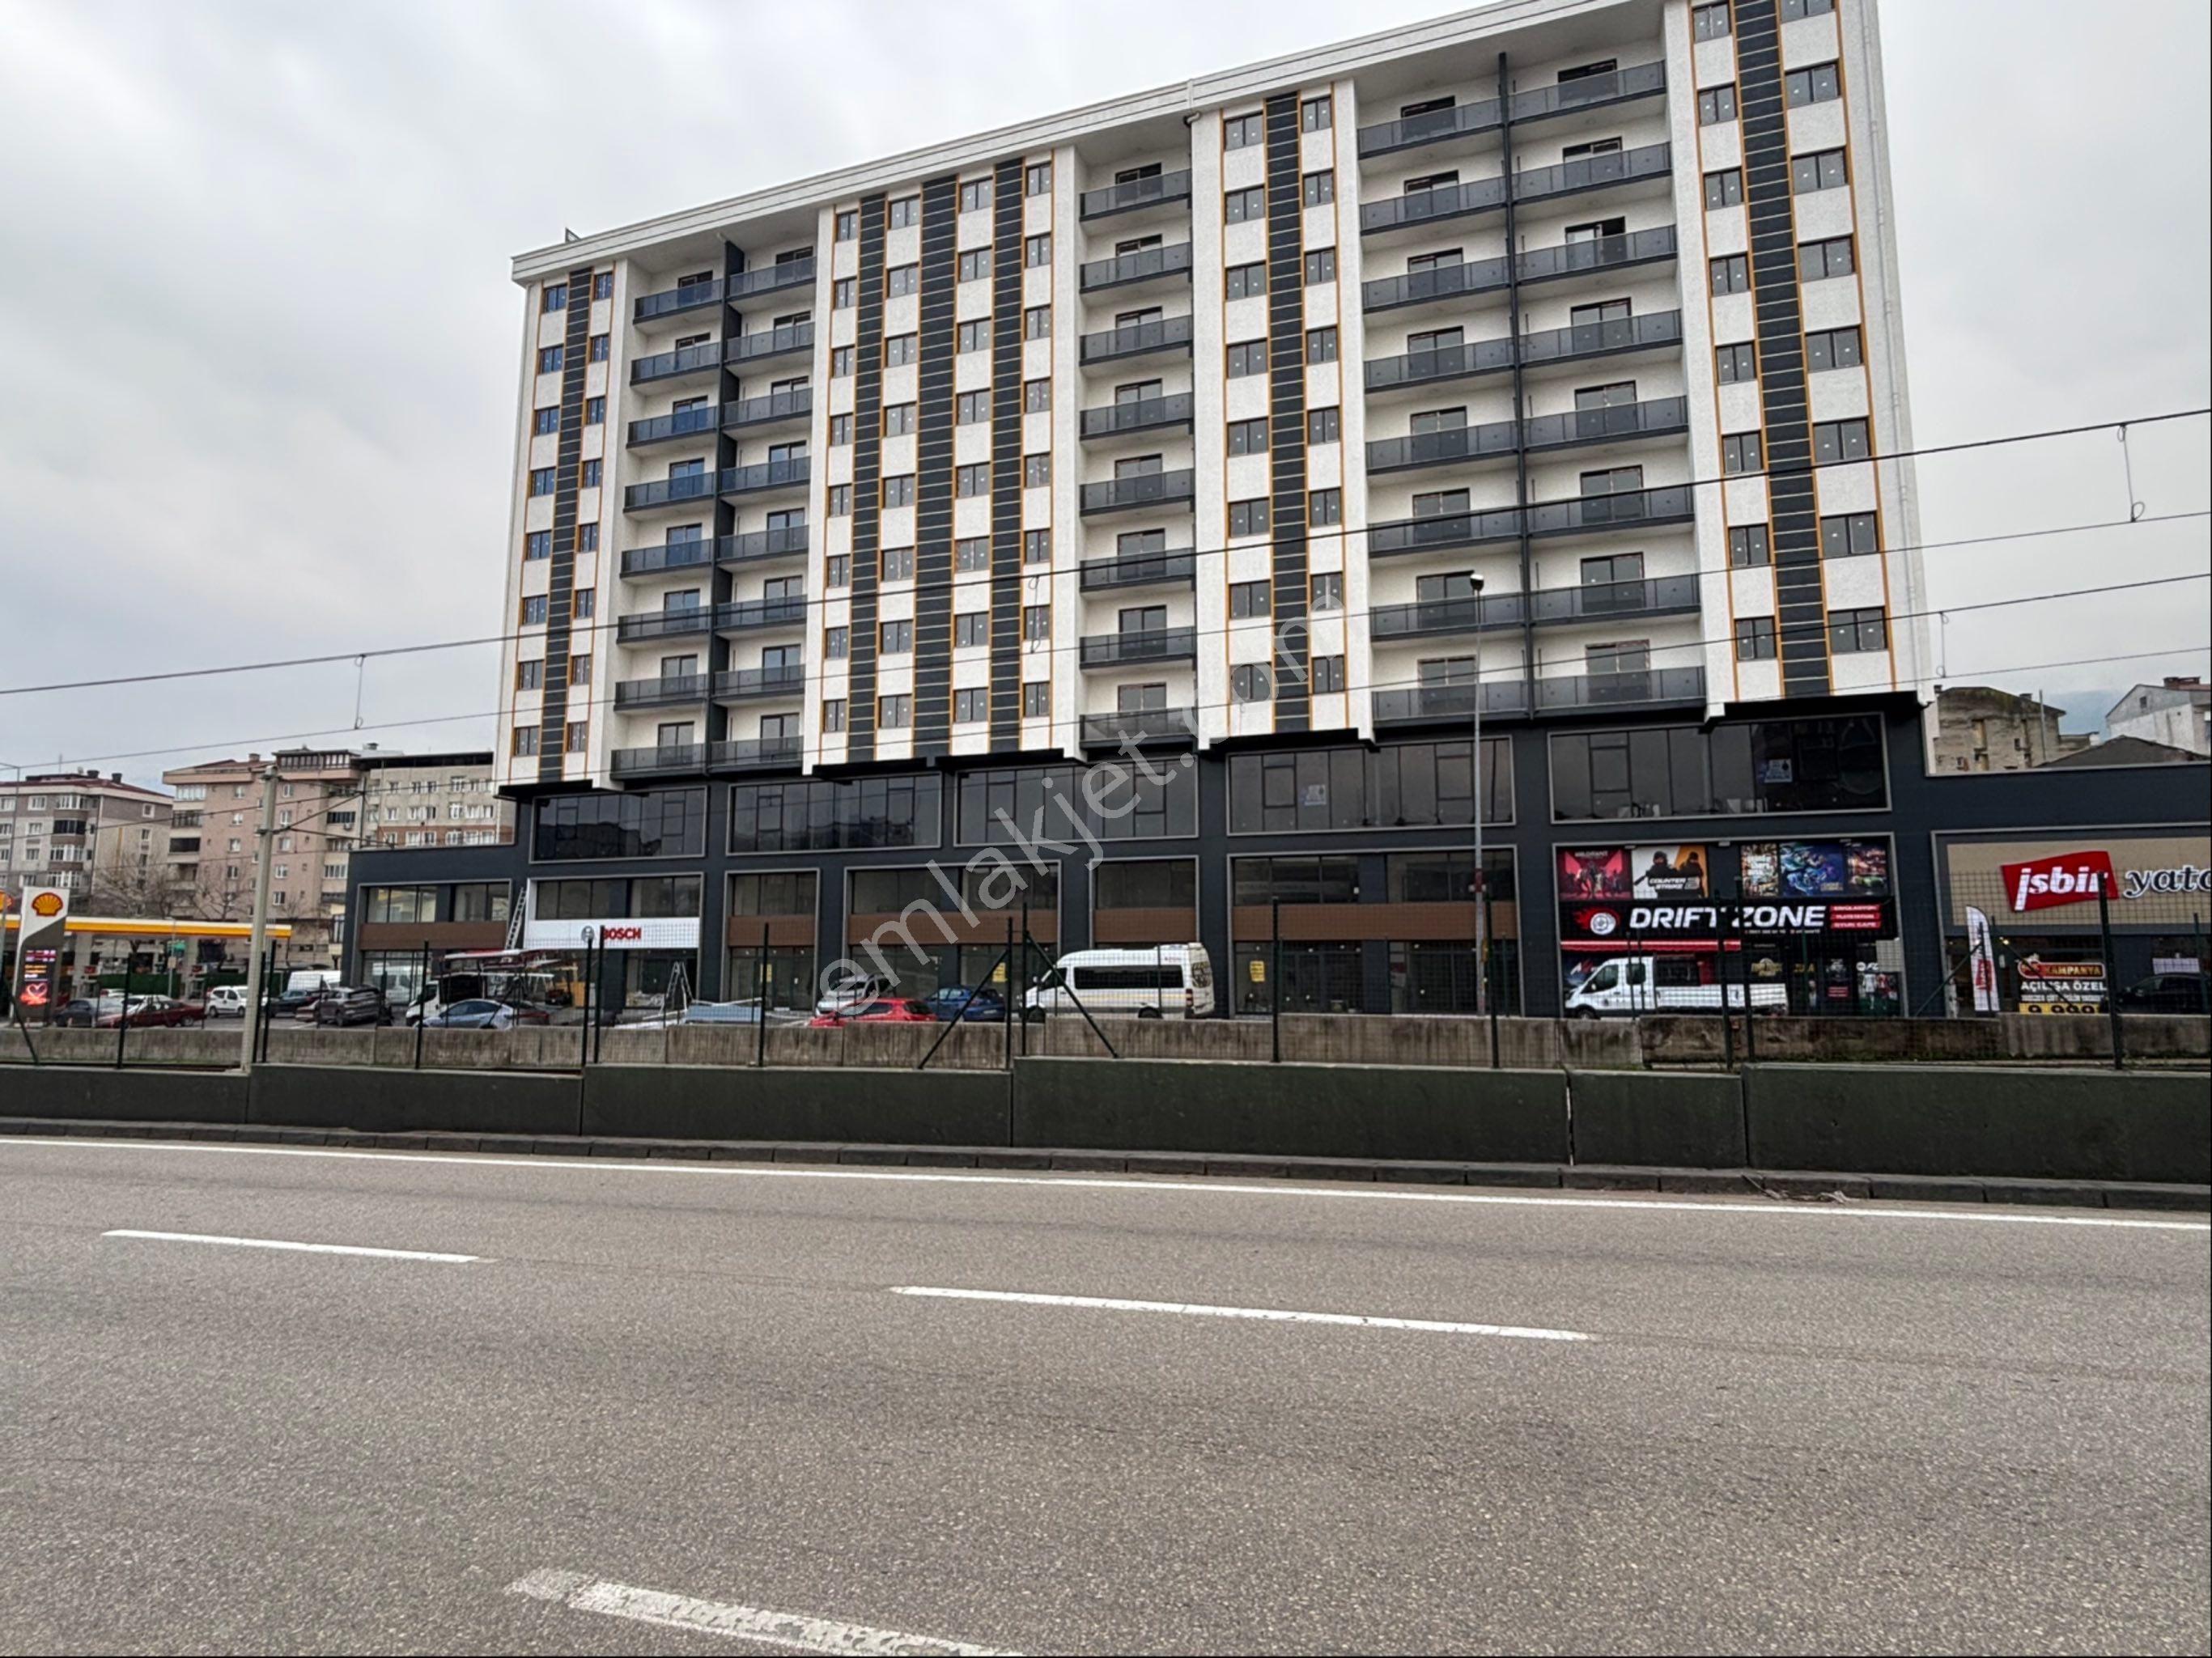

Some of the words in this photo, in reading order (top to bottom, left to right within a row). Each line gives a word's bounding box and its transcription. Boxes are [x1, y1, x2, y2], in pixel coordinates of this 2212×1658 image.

[1629, 906, 1726, 928] DRIFT
[1731, 905, 1826, 927] ZONE
[2021, 981, 2070, 993] AÇILŞA
[2073, 980, 2108, 991] ÖZEL
